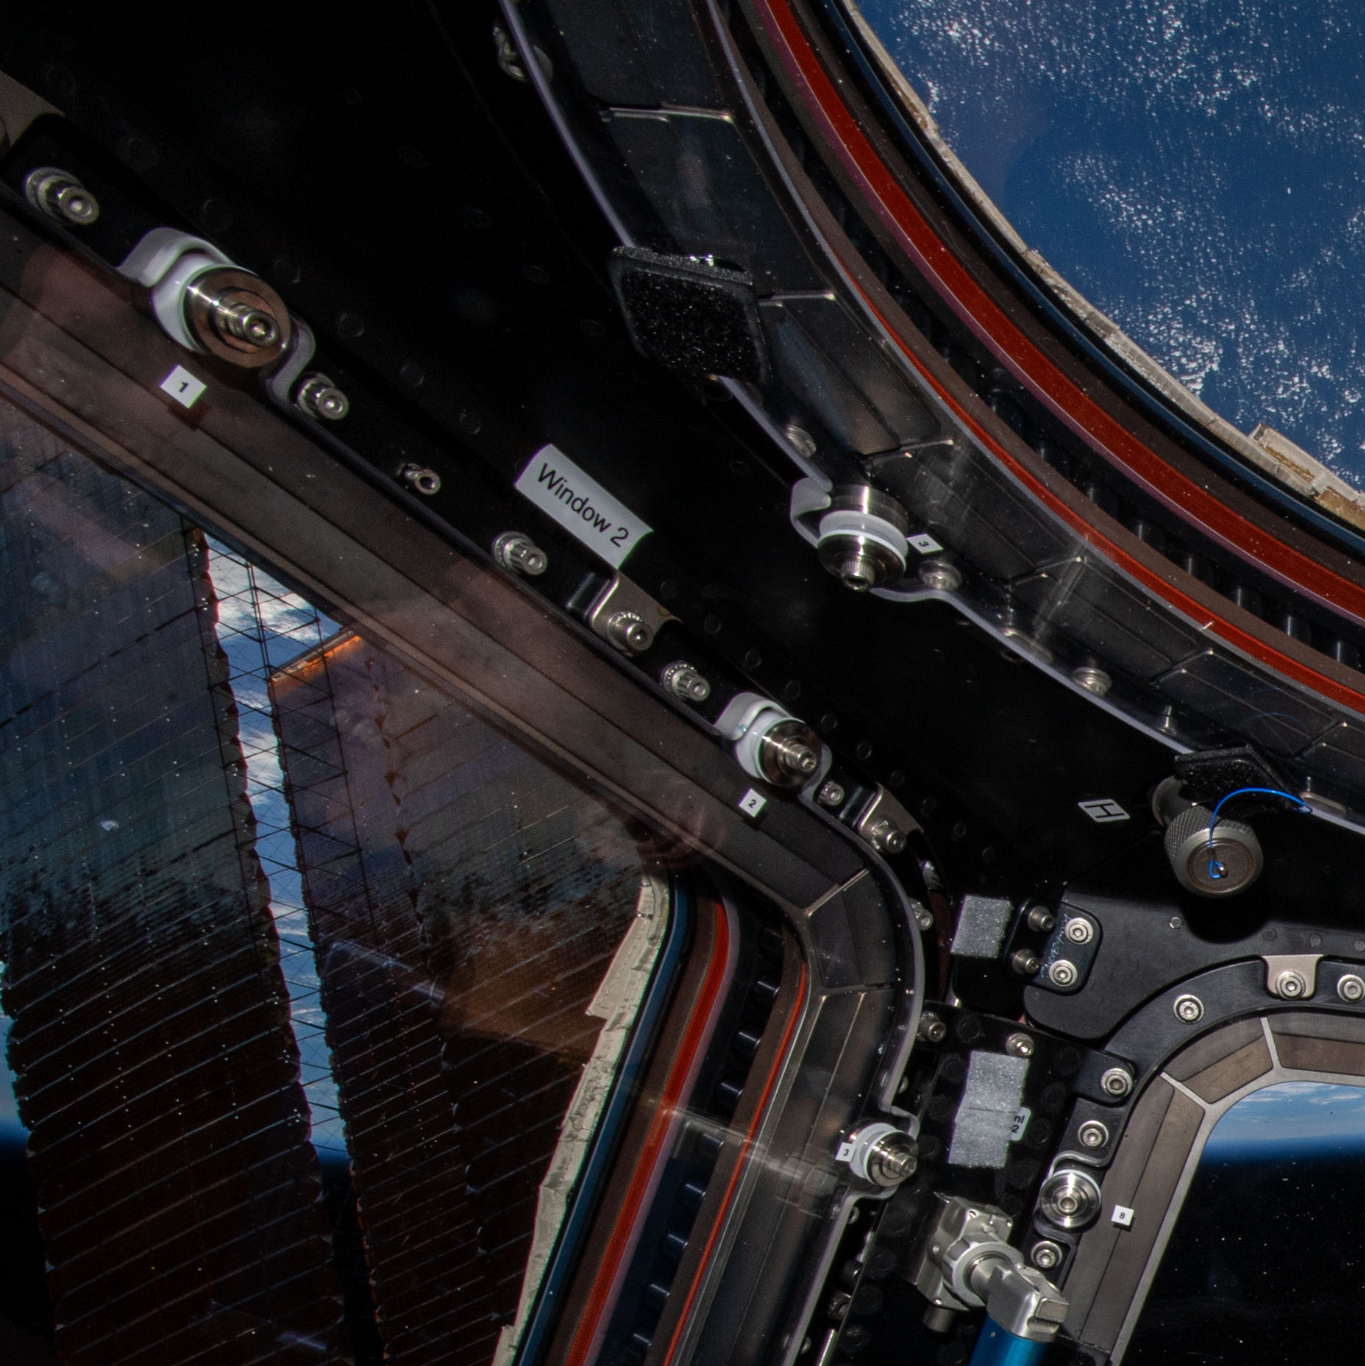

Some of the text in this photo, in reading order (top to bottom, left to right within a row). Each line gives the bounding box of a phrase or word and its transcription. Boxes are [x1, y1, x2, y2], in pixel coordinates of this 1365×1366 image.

[179, 381, 189, 394] 1
[537, 463, 630, 548] Window 2
[918, 539, 930, 548] 3
[747, 798, 757, 809] 2
[1083, 802, 1126, 820] H
[843, 1147, 850, 1157] 3
[1118, 1211, 1126, 1220] 8
